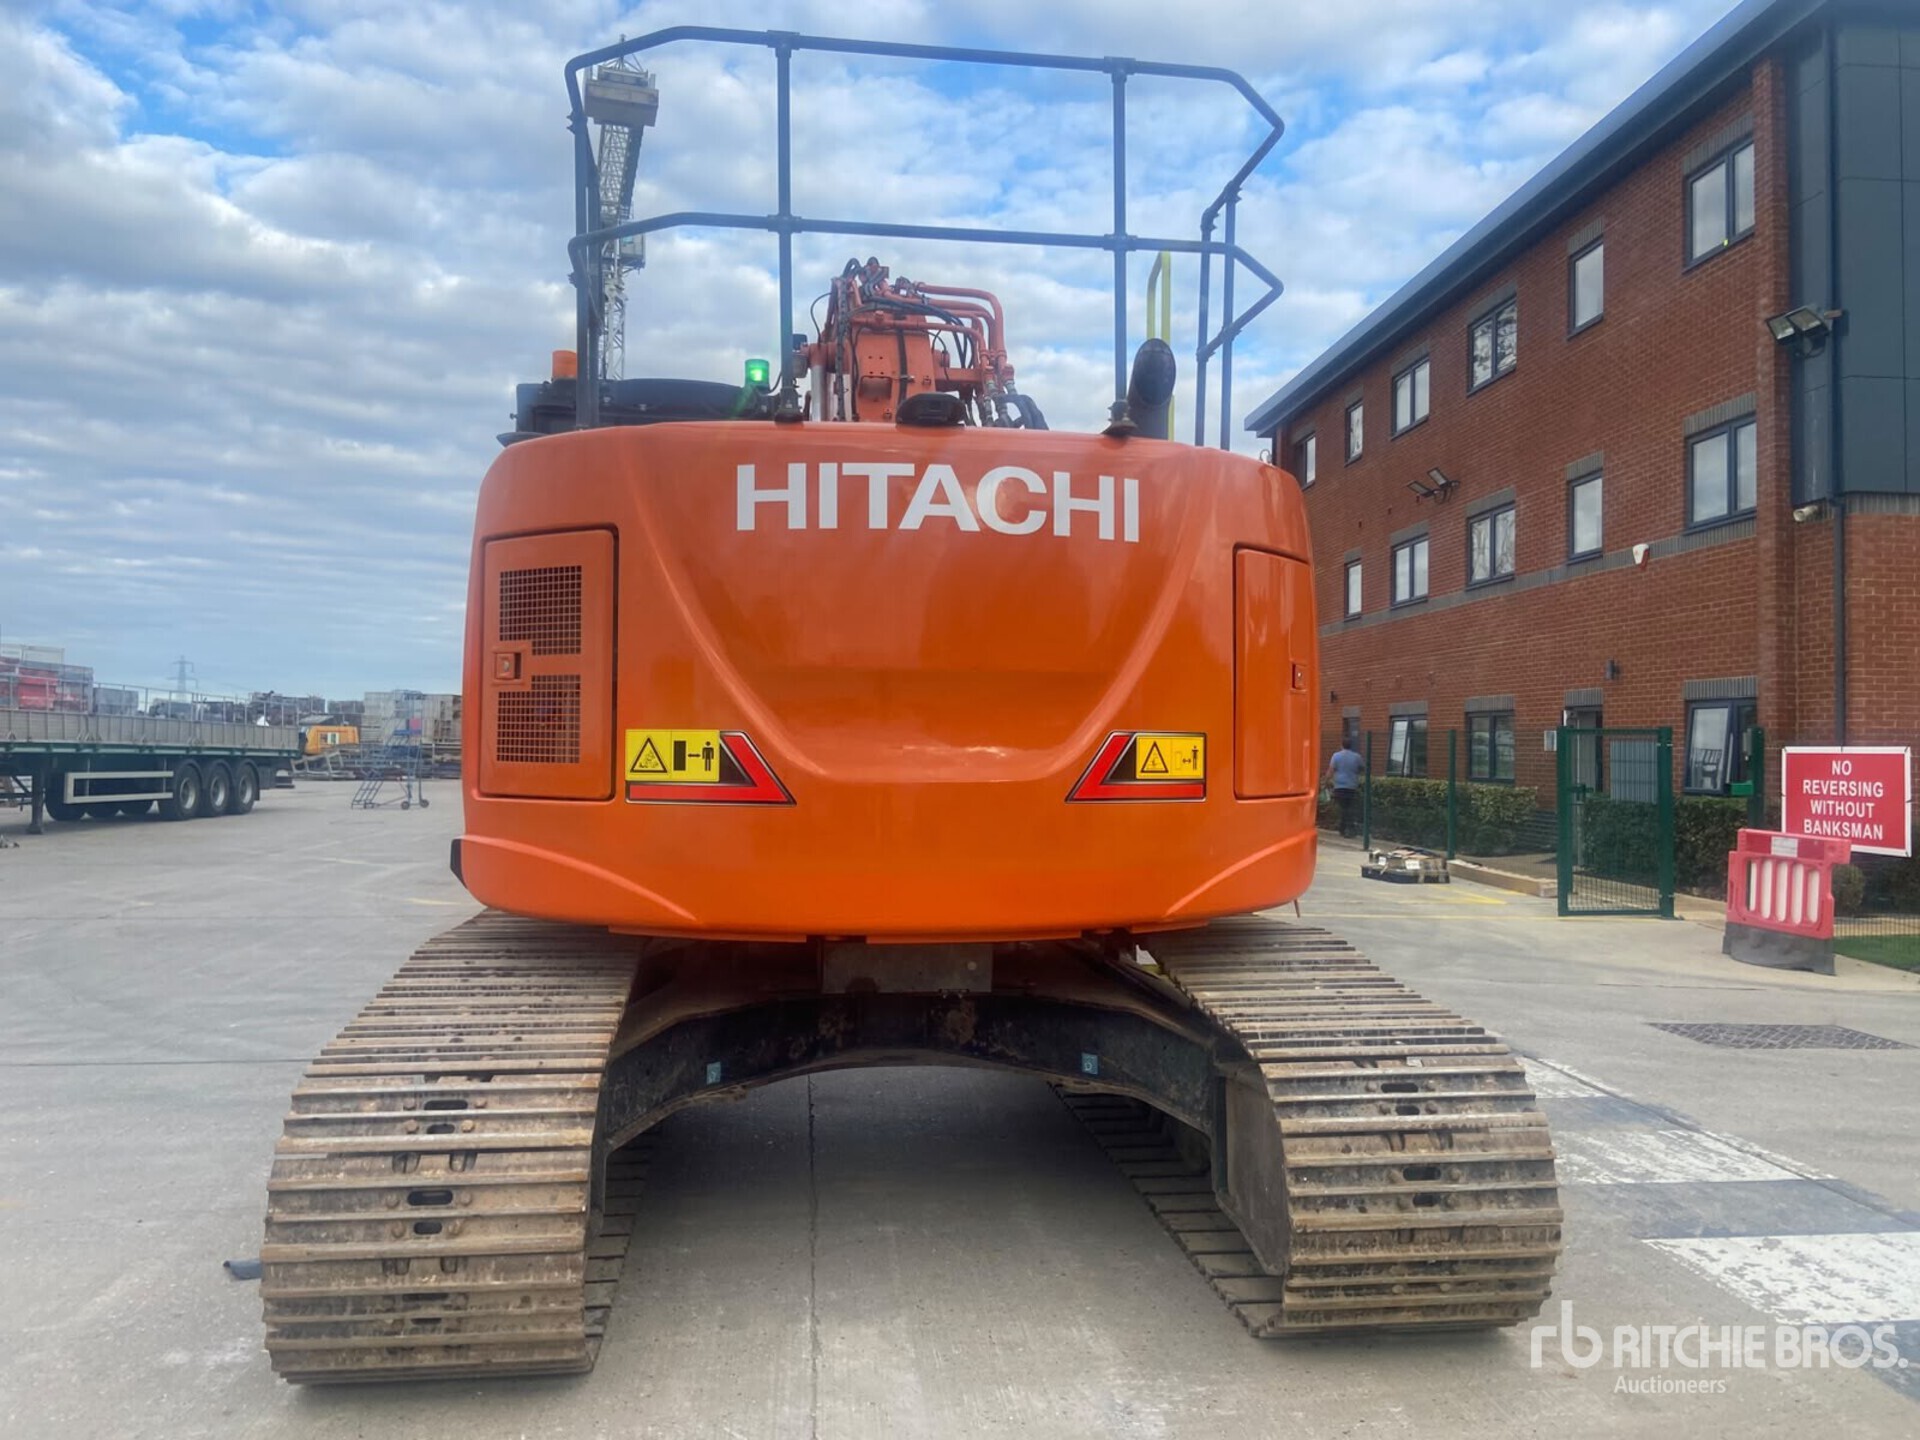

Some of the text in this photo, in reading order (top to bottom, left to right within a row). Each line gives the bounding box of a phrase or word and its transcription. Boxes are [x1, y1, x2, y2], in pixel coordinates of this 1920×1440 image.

[737, 462, 1140, 543] HITACHI
[1831, 760, 1853, 776] NO
[1803, 779, 1884, 798] REVERSING
[1810, 799, 1875, 819] WITHOUT
[1803, 818, 1883, 841] BANKSMAN
